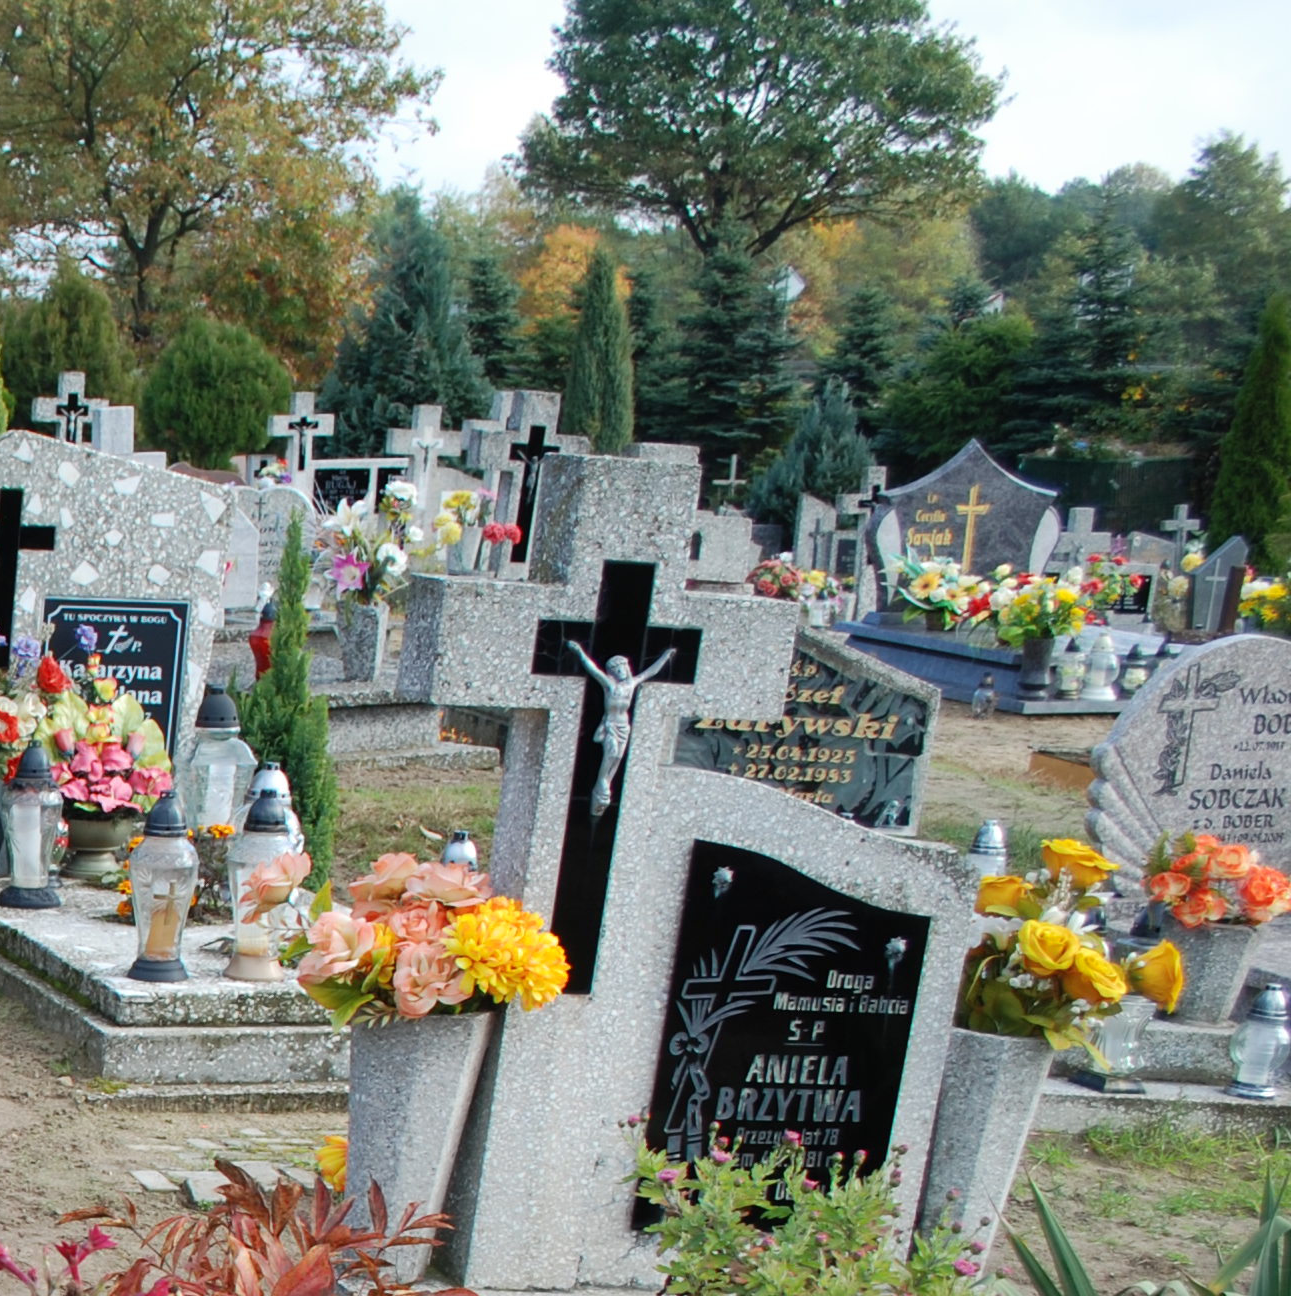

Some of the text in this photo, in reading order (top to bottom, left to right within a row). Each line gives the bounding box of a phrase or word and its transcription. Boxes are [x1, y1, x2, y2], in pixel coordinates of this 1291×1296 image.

[63, 613, 75, 621] TU
[77, 614, 127, 623] SPOCZYWA
[140, 616, 168, 625] BOGU
[59, 659, 163, 684] Kaarzyna
[785, 683, 847, 705] ózef
[745, 744, 857, 765] 25.04.1925
[1209, 762, 1272, 782] Daniela
[1188, 787, 1286, 811] SOBCZAK
[1222, 814, 1274, 829] BOBER
[826, 970, 875, 994] Droga
[773, 991, 845, 1012] Mamusia
[858, 995, 909, 1015] Babcia
[745, 1054, 850, 1085] ANIELA
[715, 1087, 862, 1123] BRZYTWA
